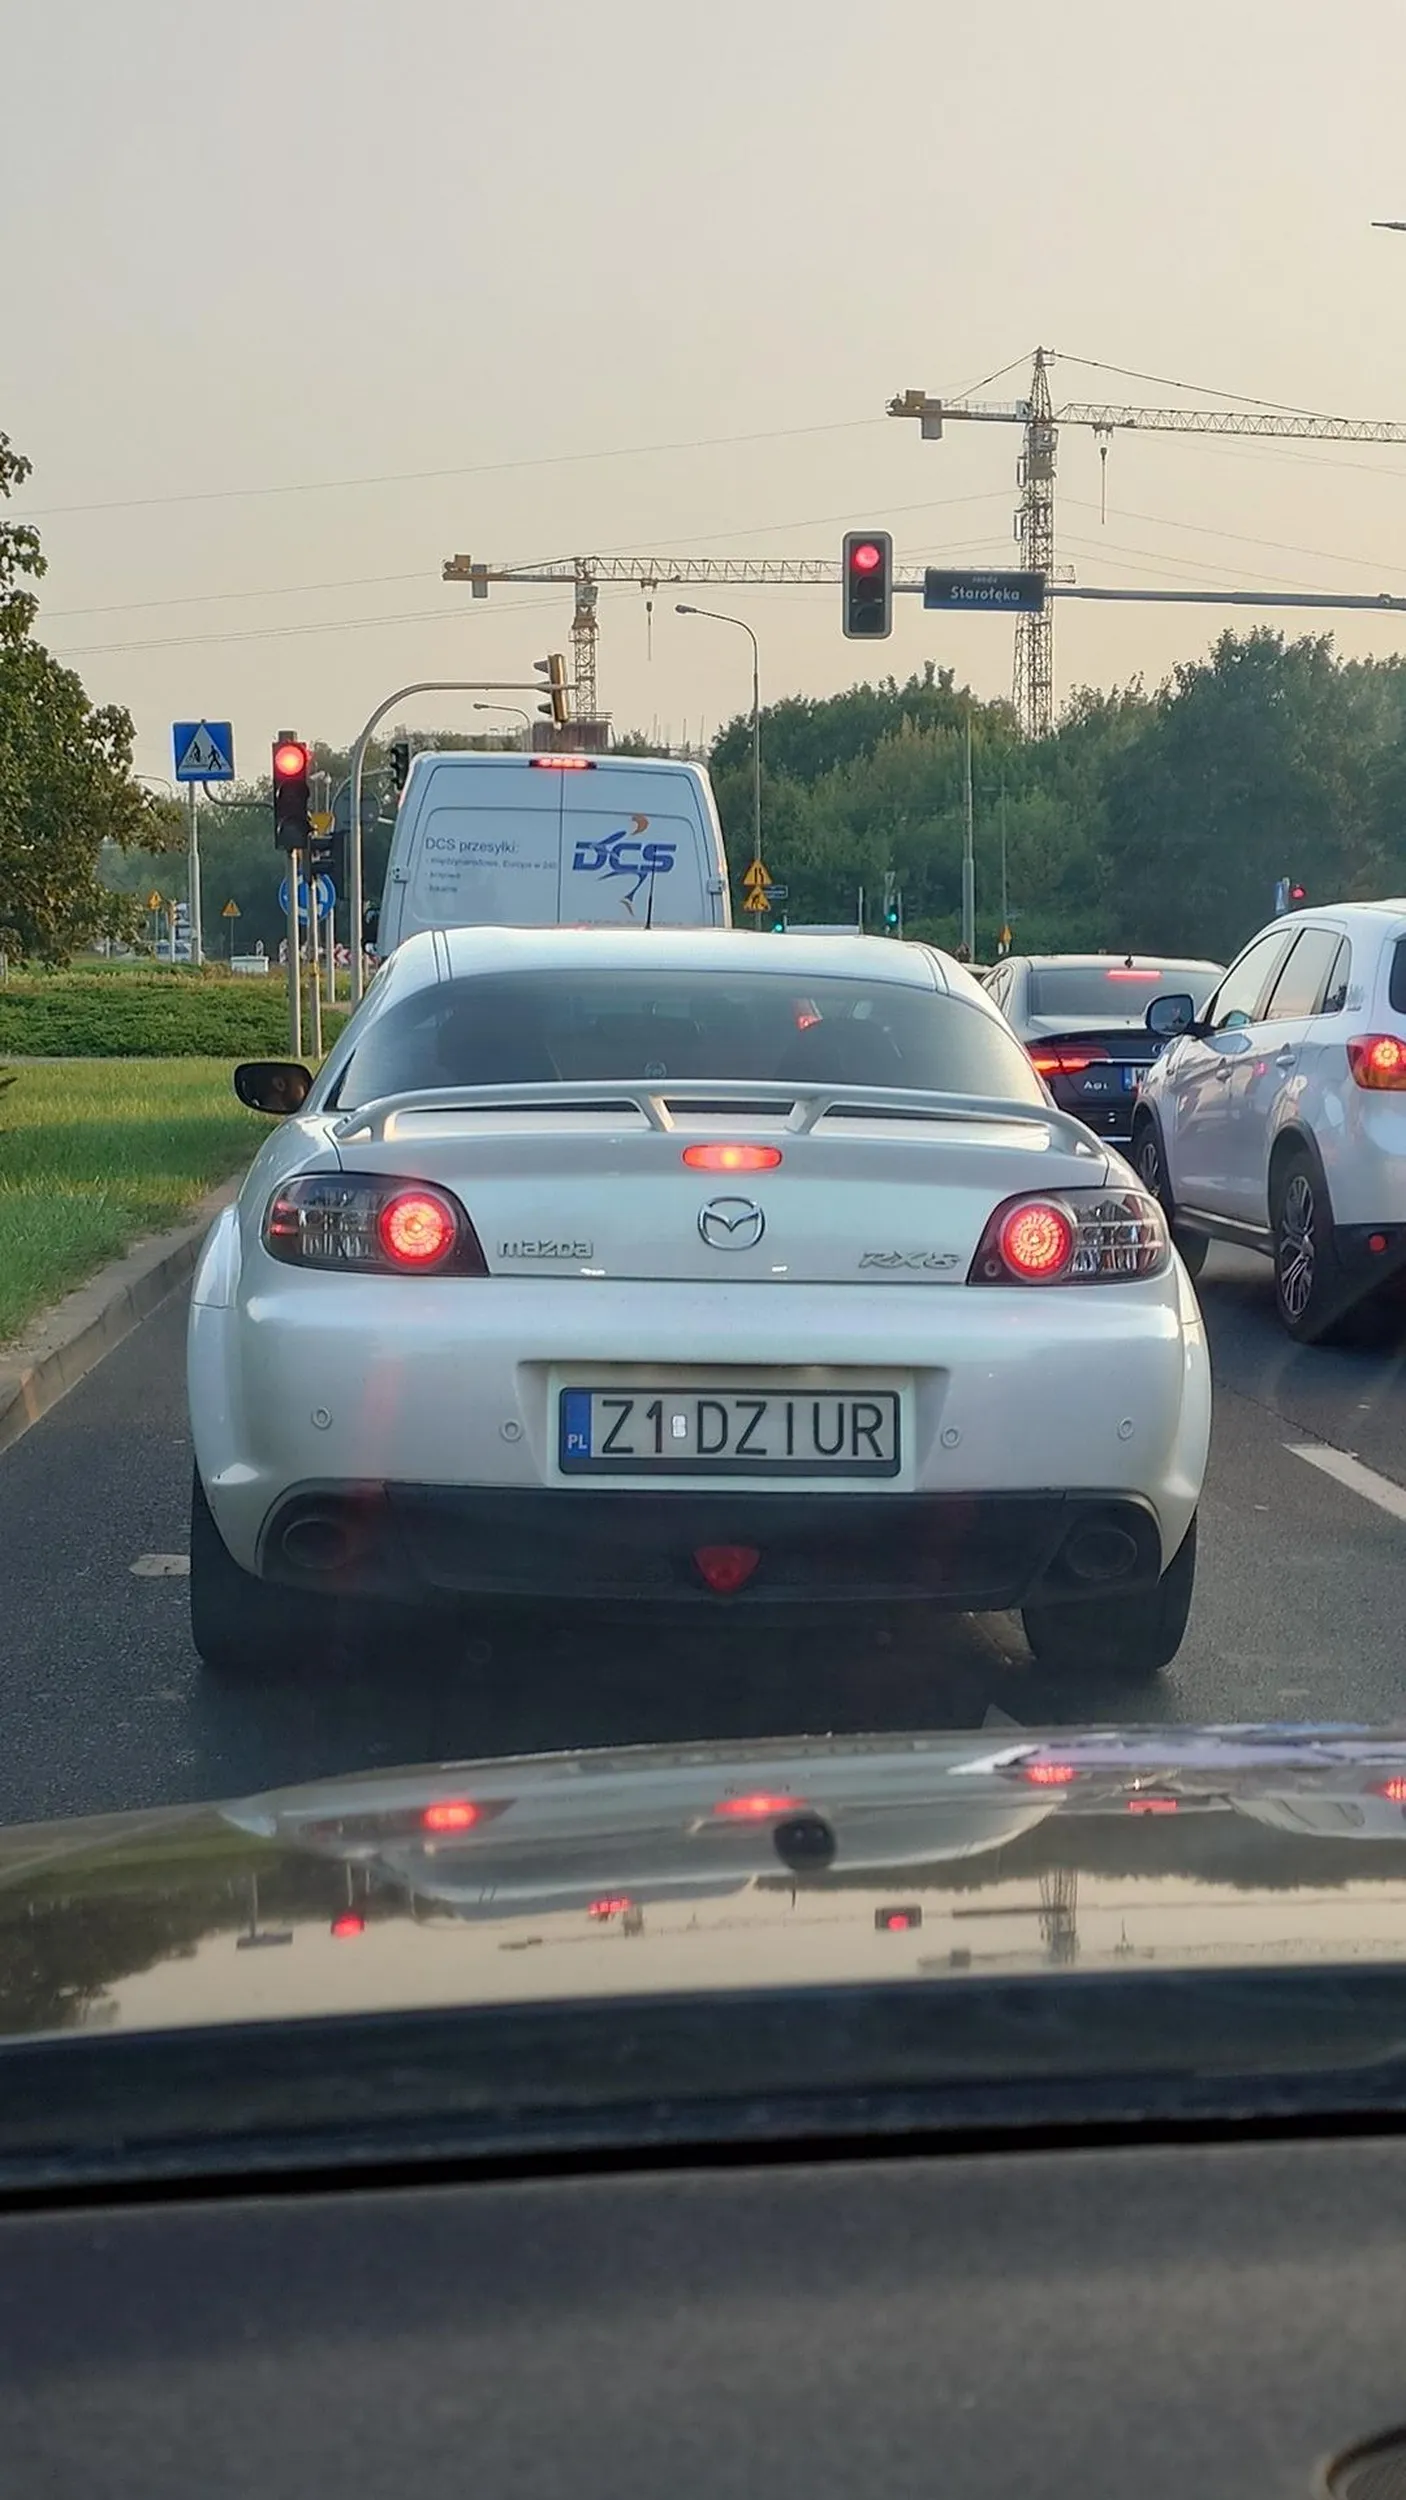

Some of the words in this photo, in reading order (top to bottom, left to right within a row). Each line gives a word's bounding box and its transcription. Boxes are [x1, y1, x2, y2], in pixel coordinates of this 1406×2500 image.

[950, 585, 1020, 603] Starołęka
[425, 838, 456, 850] DCS
[573, 841, 676, 873] DCS
[497, 1240, 594, 1259] mazda
[601, 1400, 663, 1454] Z1
[697, 1401, 884, 1458] DZIUR
[567, 1434, 588, 1450] PL
